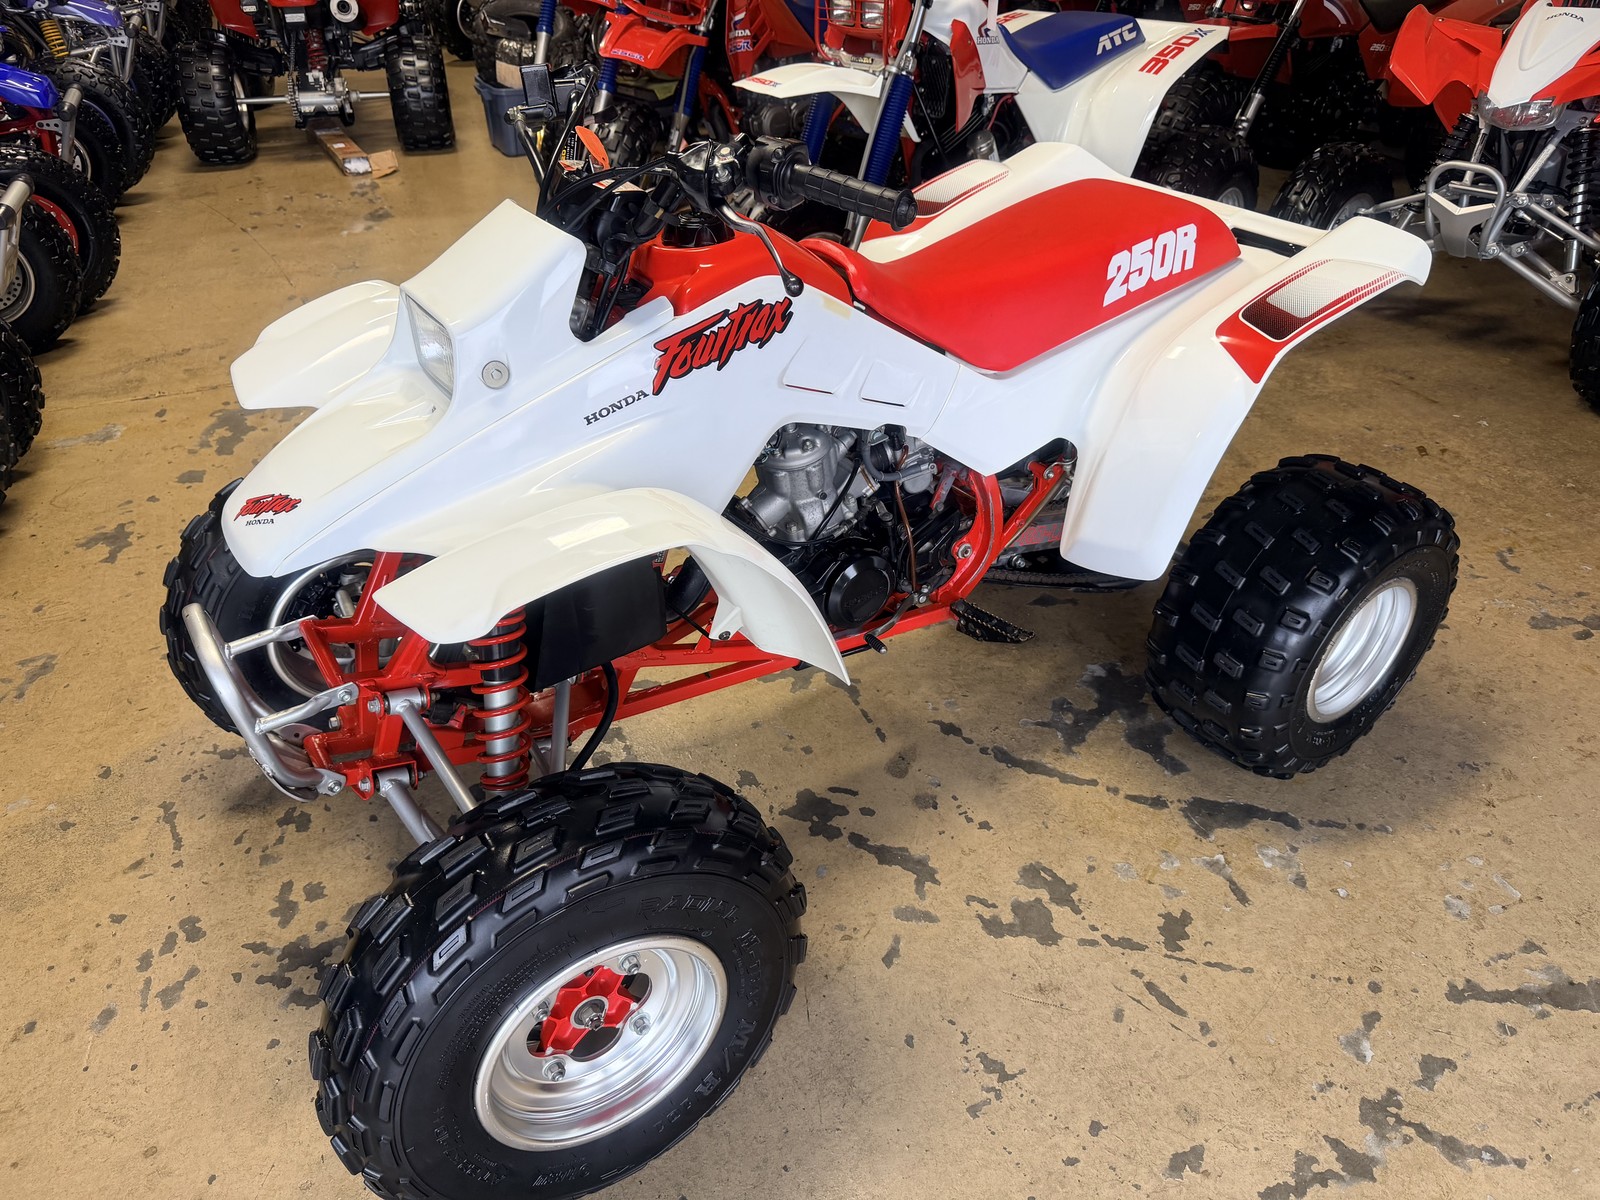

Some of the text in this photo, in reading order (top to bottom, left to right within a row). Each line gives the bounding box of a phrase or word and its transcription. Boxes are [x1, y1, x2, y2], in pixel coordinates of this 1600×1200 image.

[1545, 12, 1584, 22] HONDA
[977, 35, 1000, 45] HONDA
[1096, 22, 1137, 56] ATC
[1138, 27, 1217, 76] 350X
[1103, 223, 1198, 308] 250R
[584, 389, 650, 427] HONDA
[245, 518, 275, 527] HONDA
